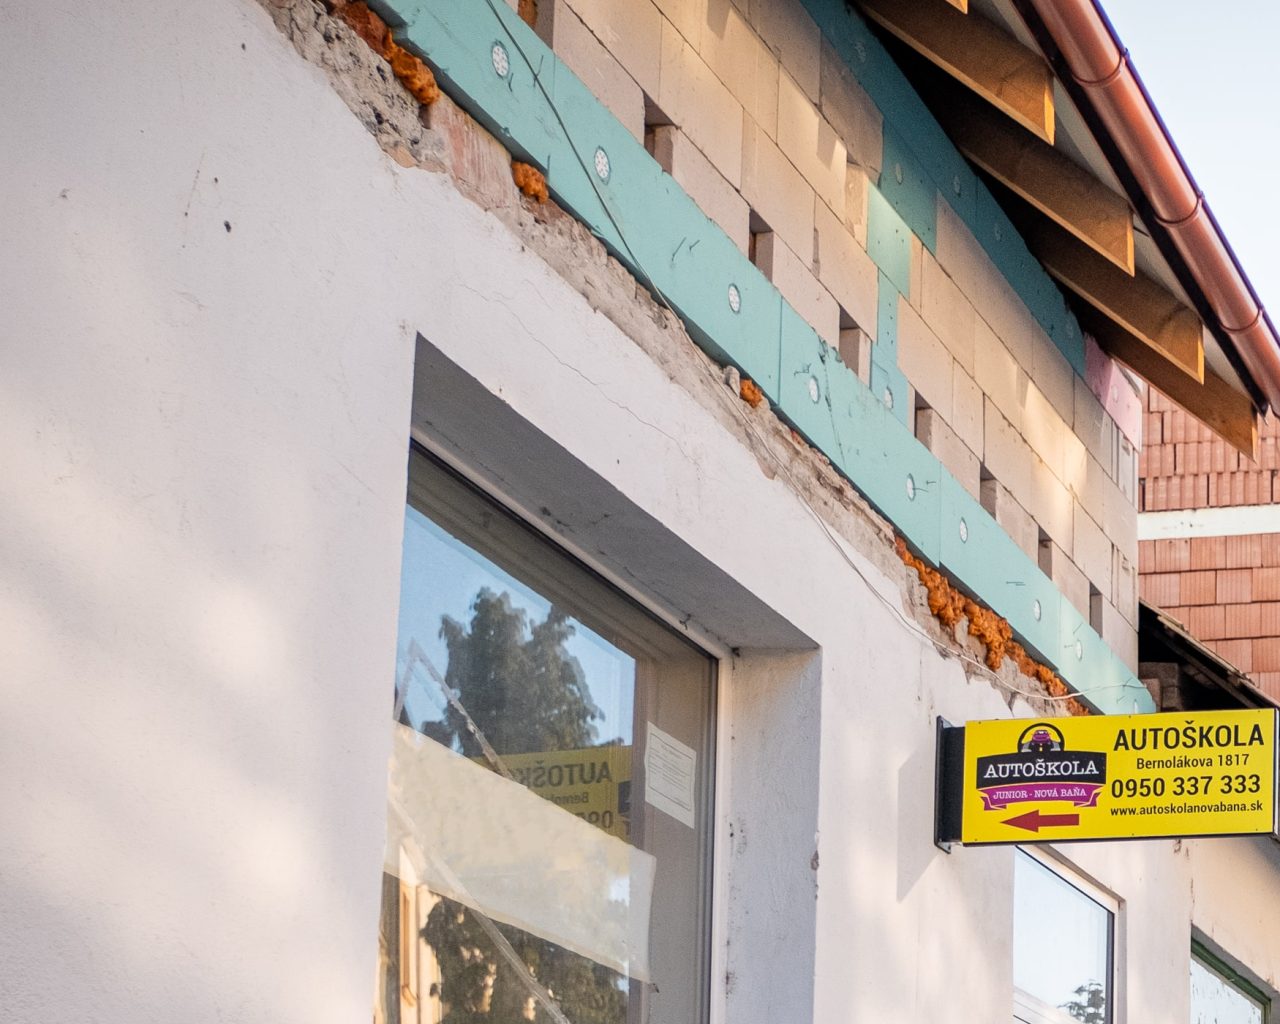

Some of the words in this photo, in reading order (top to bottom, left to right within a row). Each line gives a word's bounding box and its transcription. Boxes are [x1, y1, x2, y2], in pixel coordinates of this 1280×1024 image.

[1113, 720, 1265, 751] AUTOŠKOLA
[983, 758, 1099, 779] AUTOŠKOLA
[1136, 755, 1213, 770] Bernolákova
[1218, 753, 1250, 767] 1817
[992, 790, 1028, 800] JUNIOR
[1034, 788, 1059, 798] NOVÁ
[1060, 787, 1087, 797] BAŇA
[1111, 777, 1165, 798] 0950
[1172, 775, 1213, 796] 337
[1220, 774, 1261, 794] 333
[1110, 800, 1263, 816] www.autoskolanovabana.sk
